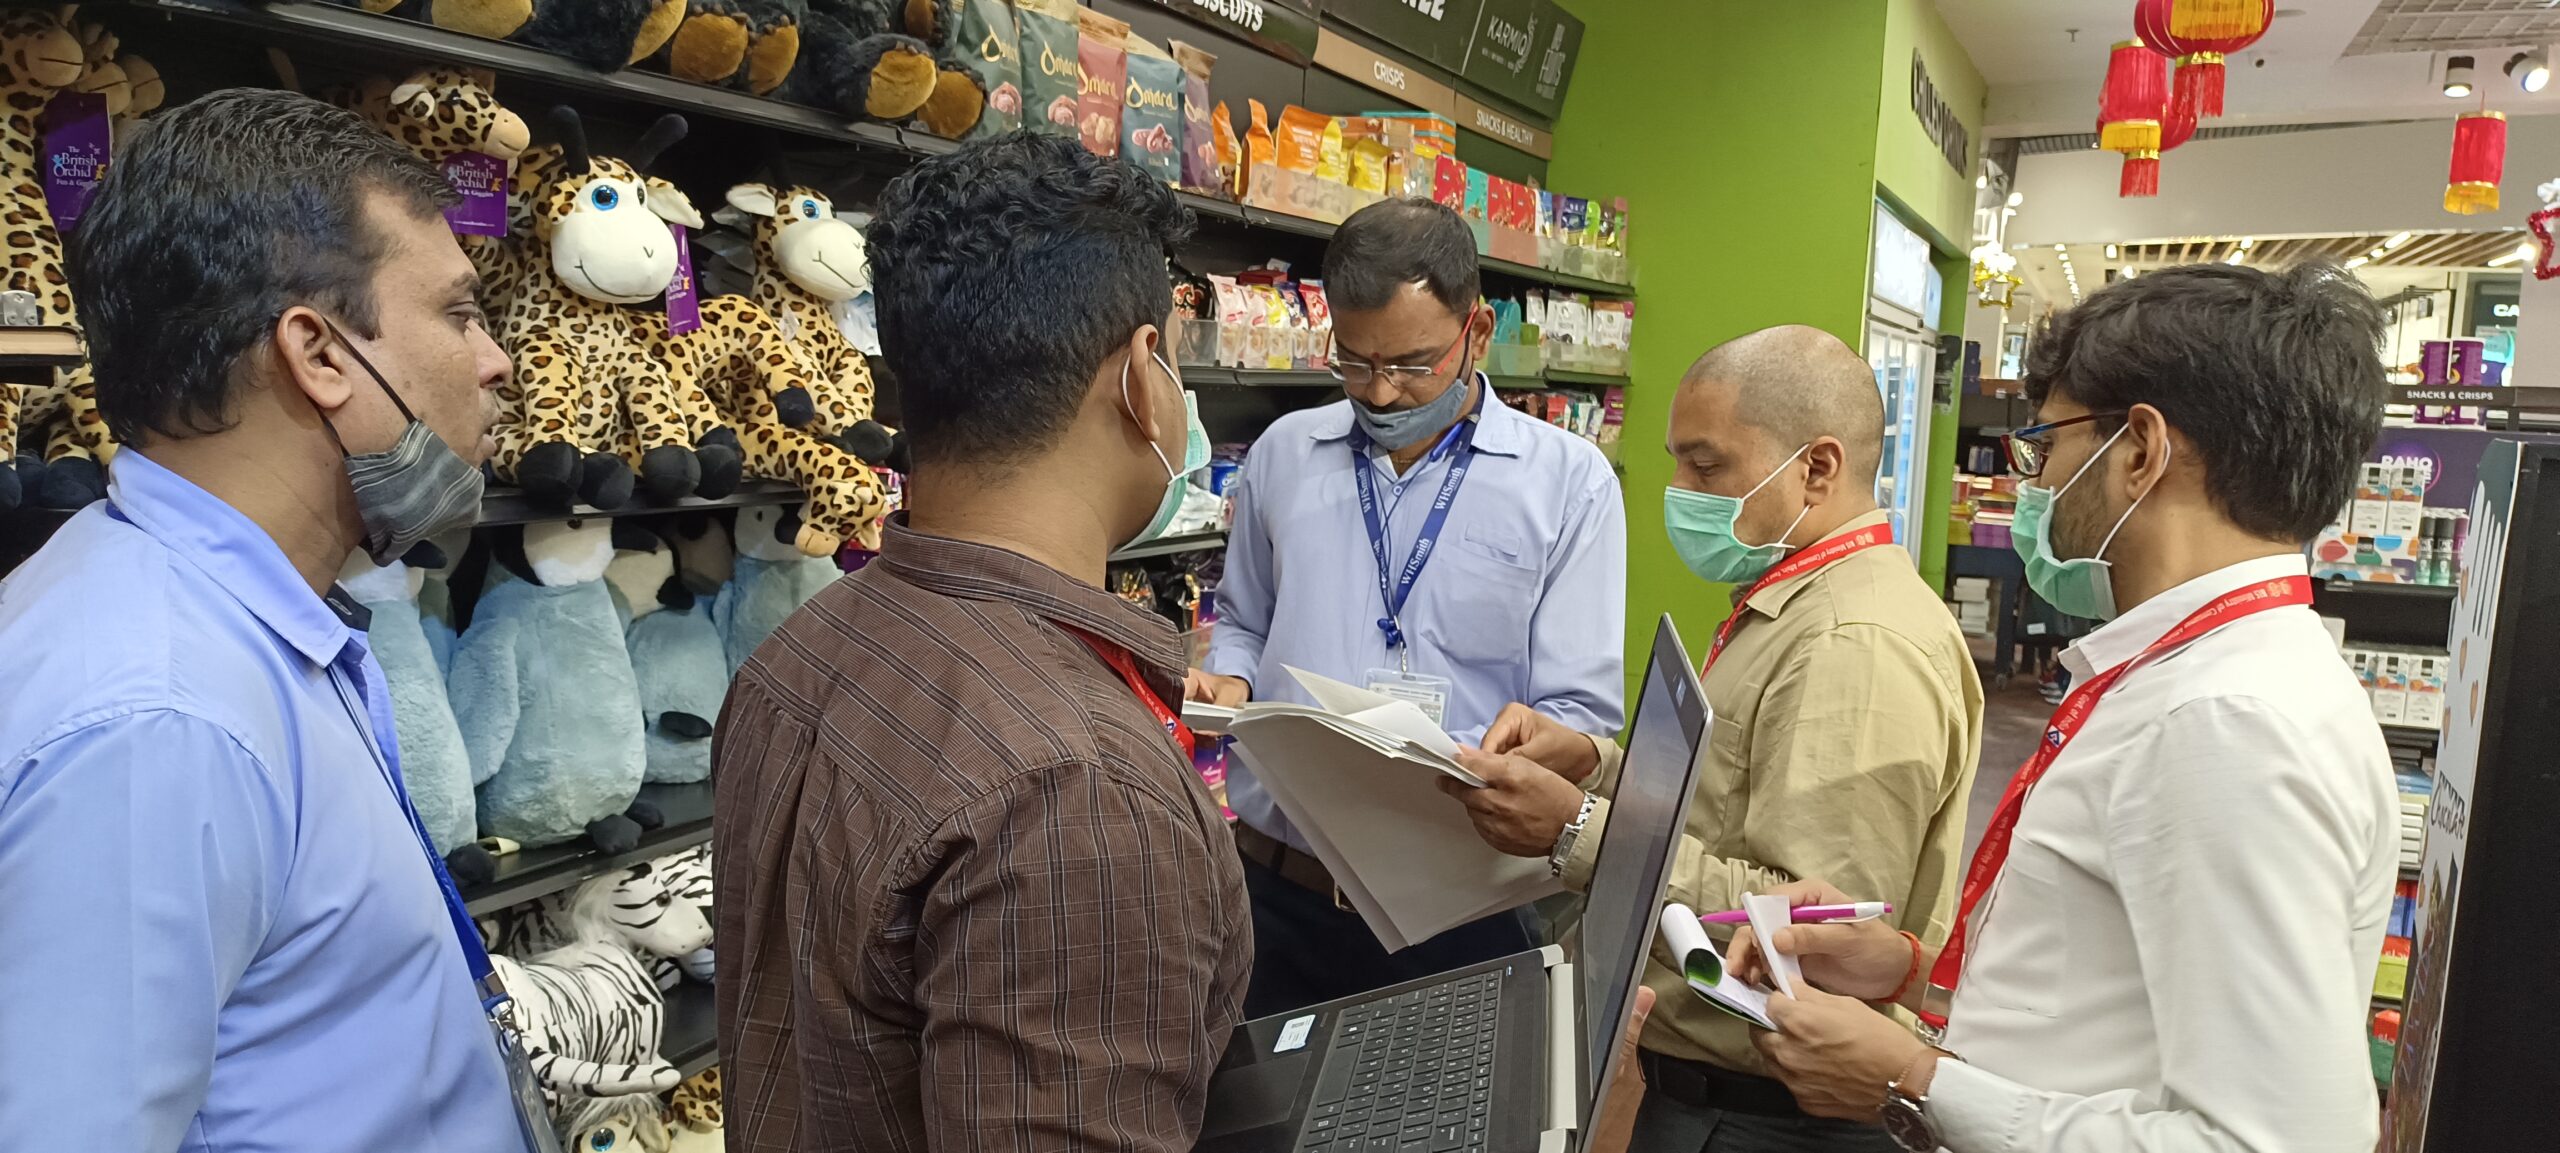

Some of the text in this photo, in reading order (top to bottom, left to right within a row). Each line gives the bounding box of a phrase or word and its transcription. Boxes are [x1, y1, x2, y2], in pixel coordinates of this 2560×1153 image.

[1374, 61, 1406, 91] CRISPS
[61, 152, 97, 166] British
[53, 164, 91, 178] Orchid
[456, 165, 493, 179] British
[2407, 390, 2494, 401] SNACKS & CRISPS
[1357, 466, 1372, 514] WHSmith
[1434, 466, 1465, 511] WHSmith
[1401, 537, 1431, 585] WHSmith
